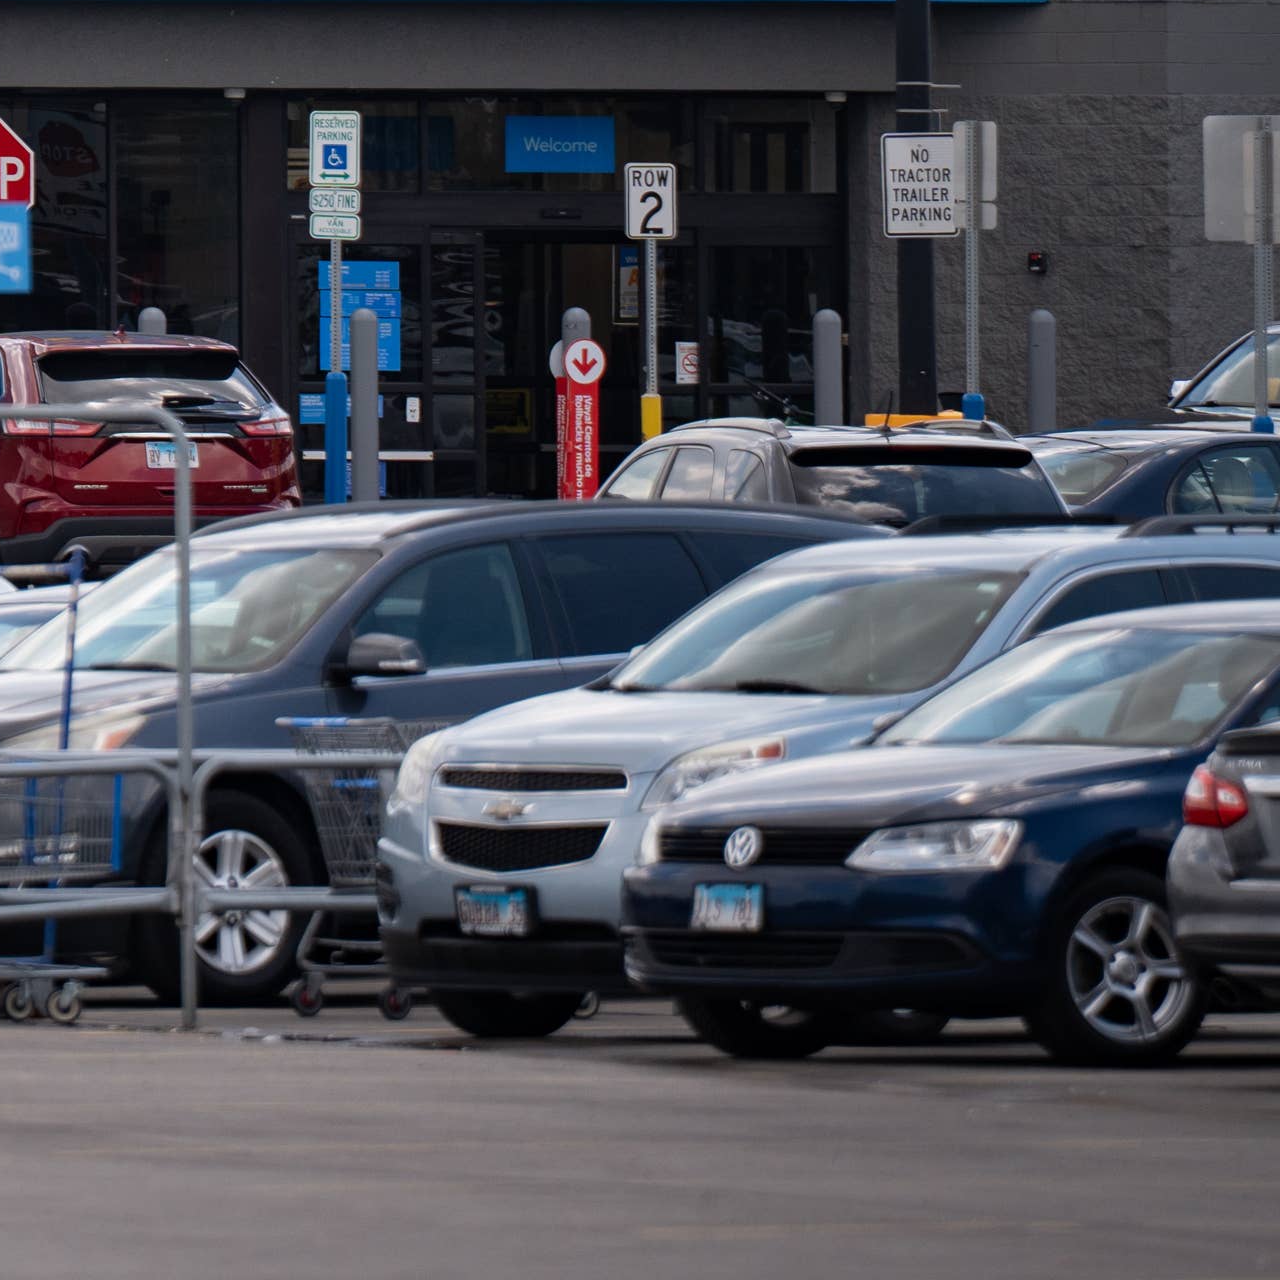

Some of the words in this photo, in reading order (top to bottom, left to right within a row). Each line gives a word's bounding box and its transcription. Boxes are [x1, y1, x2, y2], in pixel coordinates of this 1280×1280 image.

[313, 119, 356, 129] RESERVED
[317, 131, 353, 141] PARKING
[524, 135, 598, 153] Welcome
[910, 148, 929, 163] NO
[632, 169, 669, 187] ROW
[889, 167, 951, 182] TRACTOR
[311, 194, 335, 208] $250
[336, 194, 356, 209] FINE
[893, 187, 949, 202] TRAILER
[639, 190, 664, 235] 2
[891, 206, 952, 221] PARKING
[327, 219, 344, 227] VAN
[583, 394, 592, 424] ¡Vaya!
[575, 394, 583, 443] Rollbacks
[584, 426, 592, 462] Cientos
[585, 463, 592, 478] de
